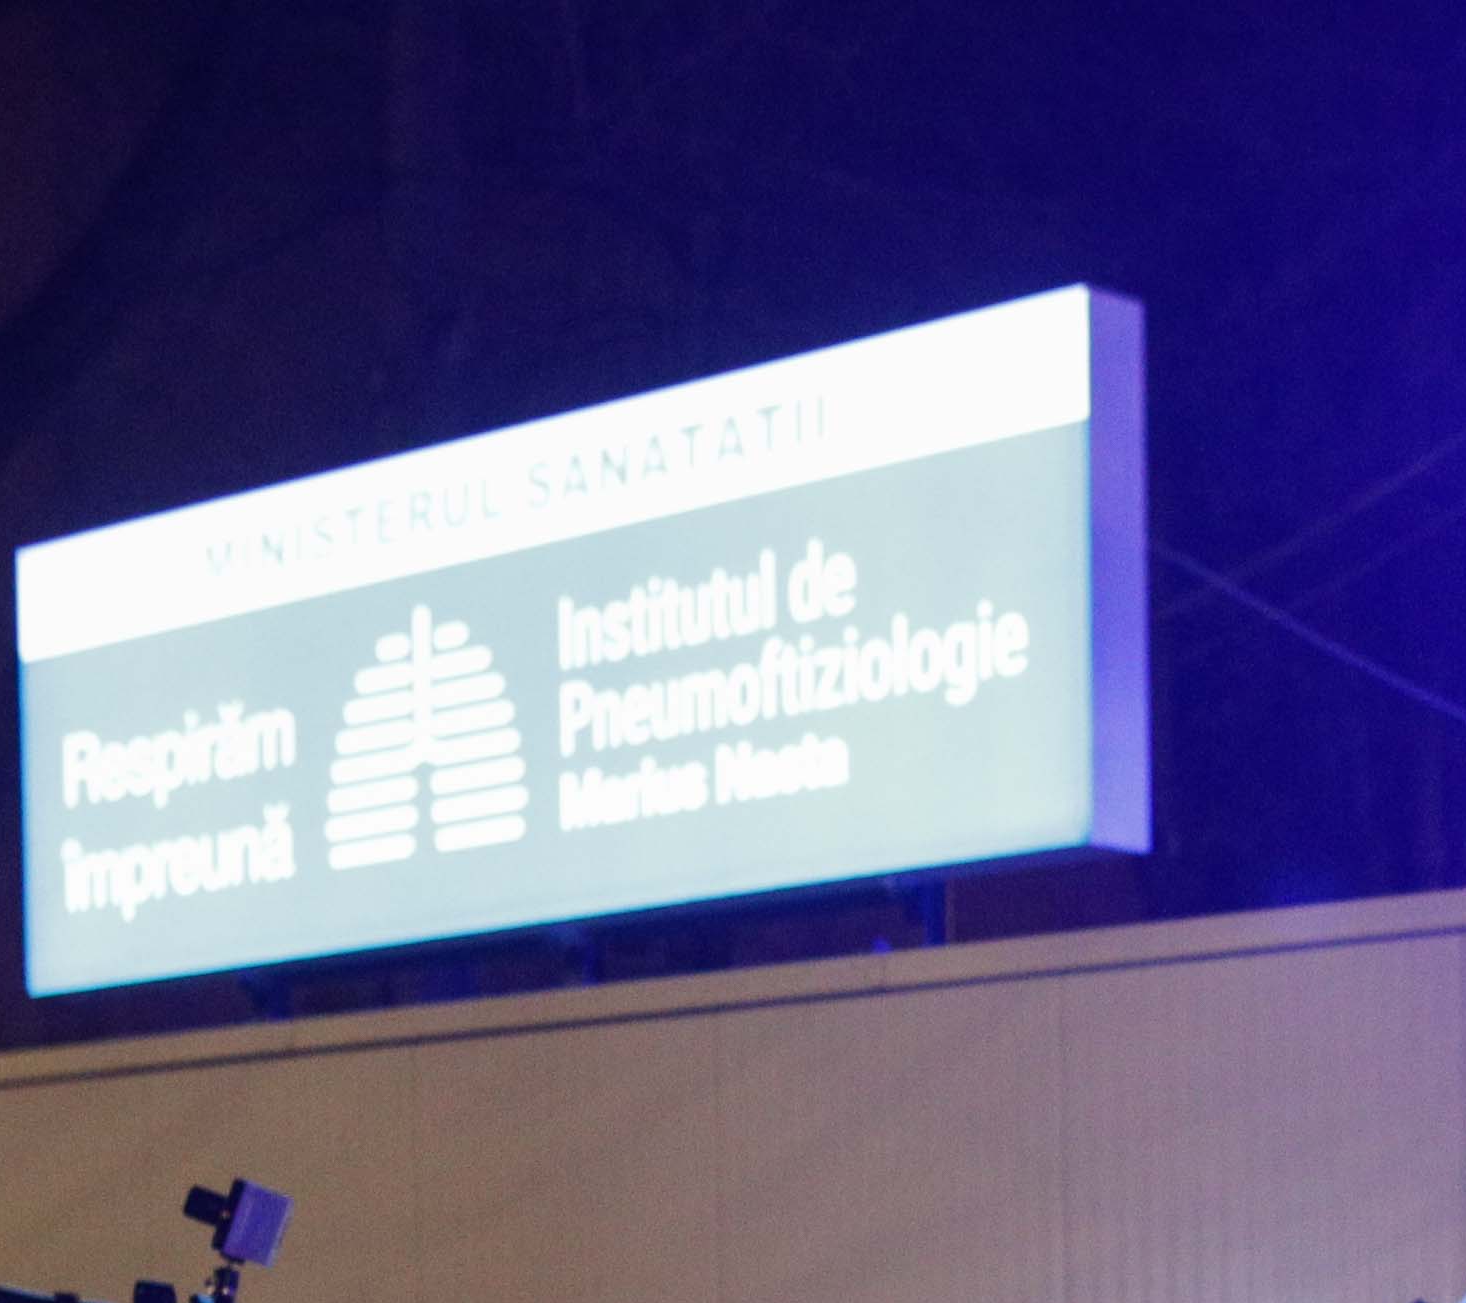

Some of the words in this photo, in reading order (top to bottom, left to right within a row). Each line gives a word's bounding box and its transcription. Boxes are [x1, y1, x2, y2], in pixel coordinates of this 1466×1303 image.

[558, 548, 777, 671] Institutul
[787, 536, 857, 624] de
[559, 599, 1031, 757] Pneumoftiziologie
